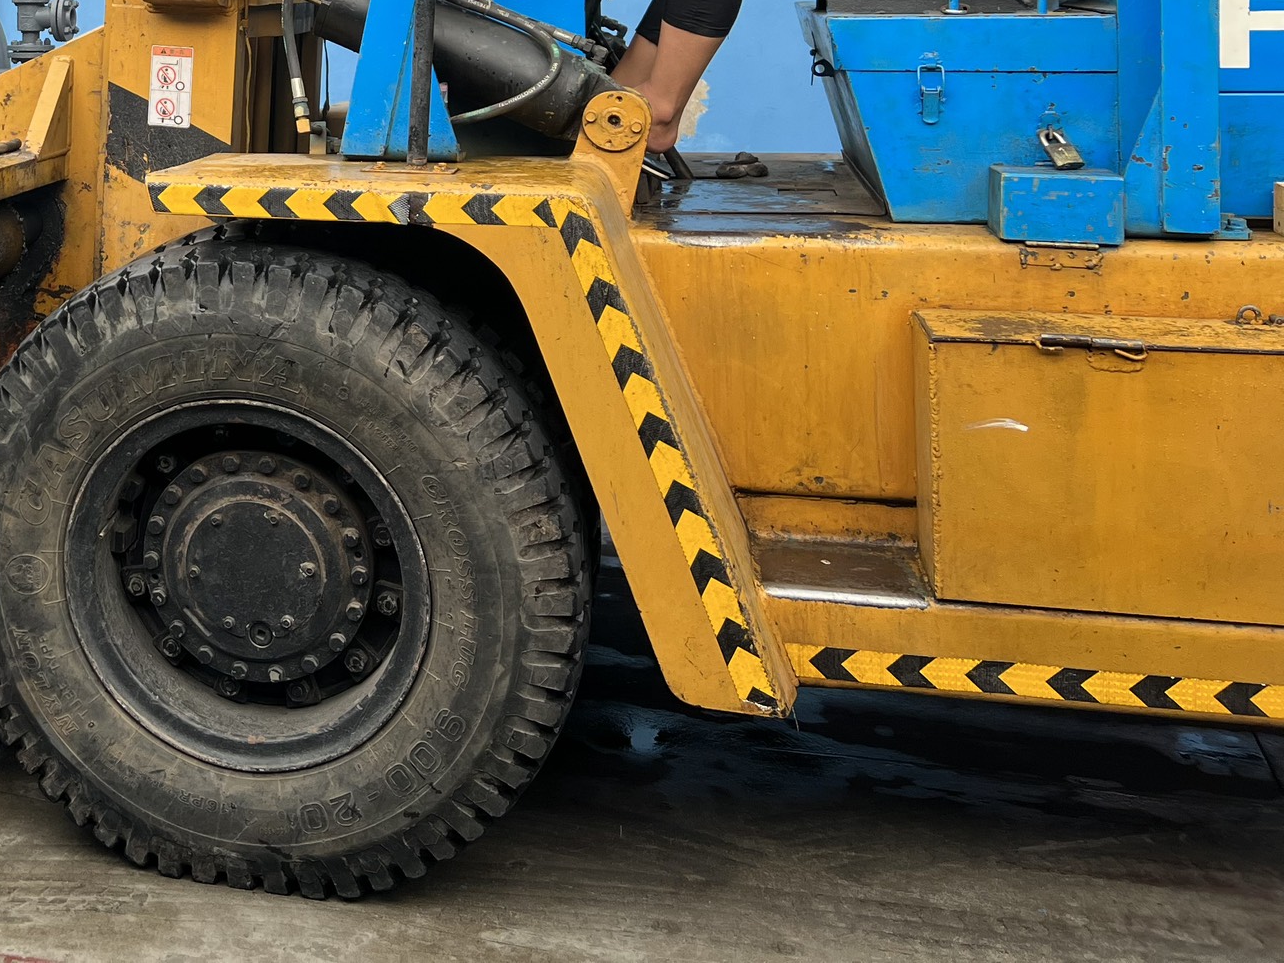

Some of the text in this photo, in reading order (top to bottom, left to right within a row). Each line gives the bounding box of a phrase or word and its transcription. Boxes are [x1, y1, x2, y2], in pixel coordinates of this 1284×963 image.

[498, 87, 536, 108] TECHNOLOGY
[537, 74, 550, 88] ITALY
[18, 347, 303, 527] CASUMINA
[420, 474, 480, 692] CROSS LUG
[9, 625, 80, 738] NYLON
[57, 682, 89, 721] TUBE
